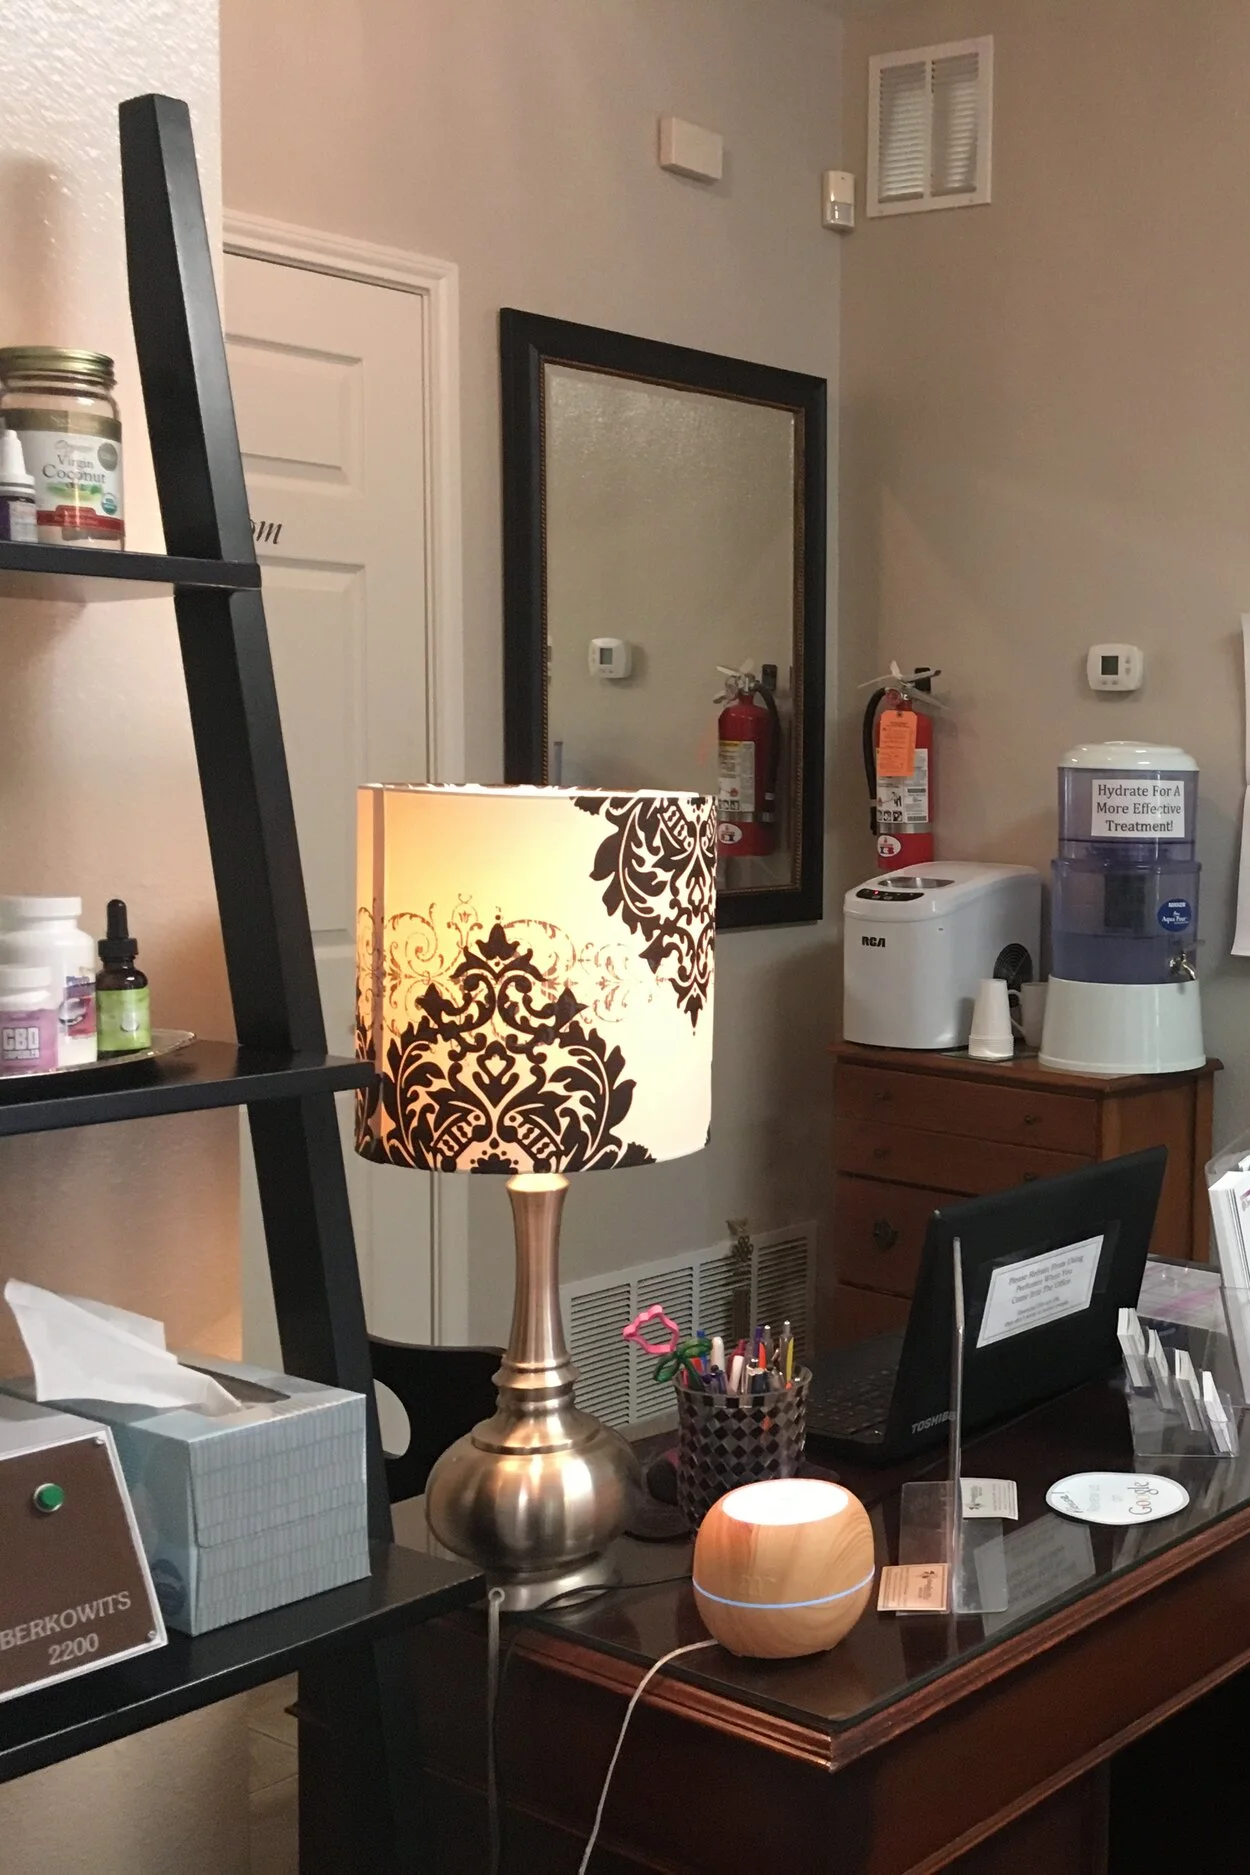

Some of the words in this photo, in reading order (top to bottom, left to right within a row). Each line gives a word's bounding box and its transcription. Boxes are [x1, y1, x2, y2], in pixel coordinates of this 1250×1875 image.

[42, 464, 106, 484] Coconut
[1098, 784, 1149, 799] Hydrate
[1152, 785, 1171, 797] For
[1173, 785, 1181, 797] A
[1096, 802, 1129, 814] More
[1133, 802, 1181, 814] Effective
[1105, 820, 1174, 832] Treatment!
[862, 936, 886, 948] RCA
[3, 1027, 39, 1050] CBD
[1127, 1481, 1159, 1516] Google
[0, 1591, 131, 1650] BERKOWITS
[48, 1633, 99, 1665] 2200
